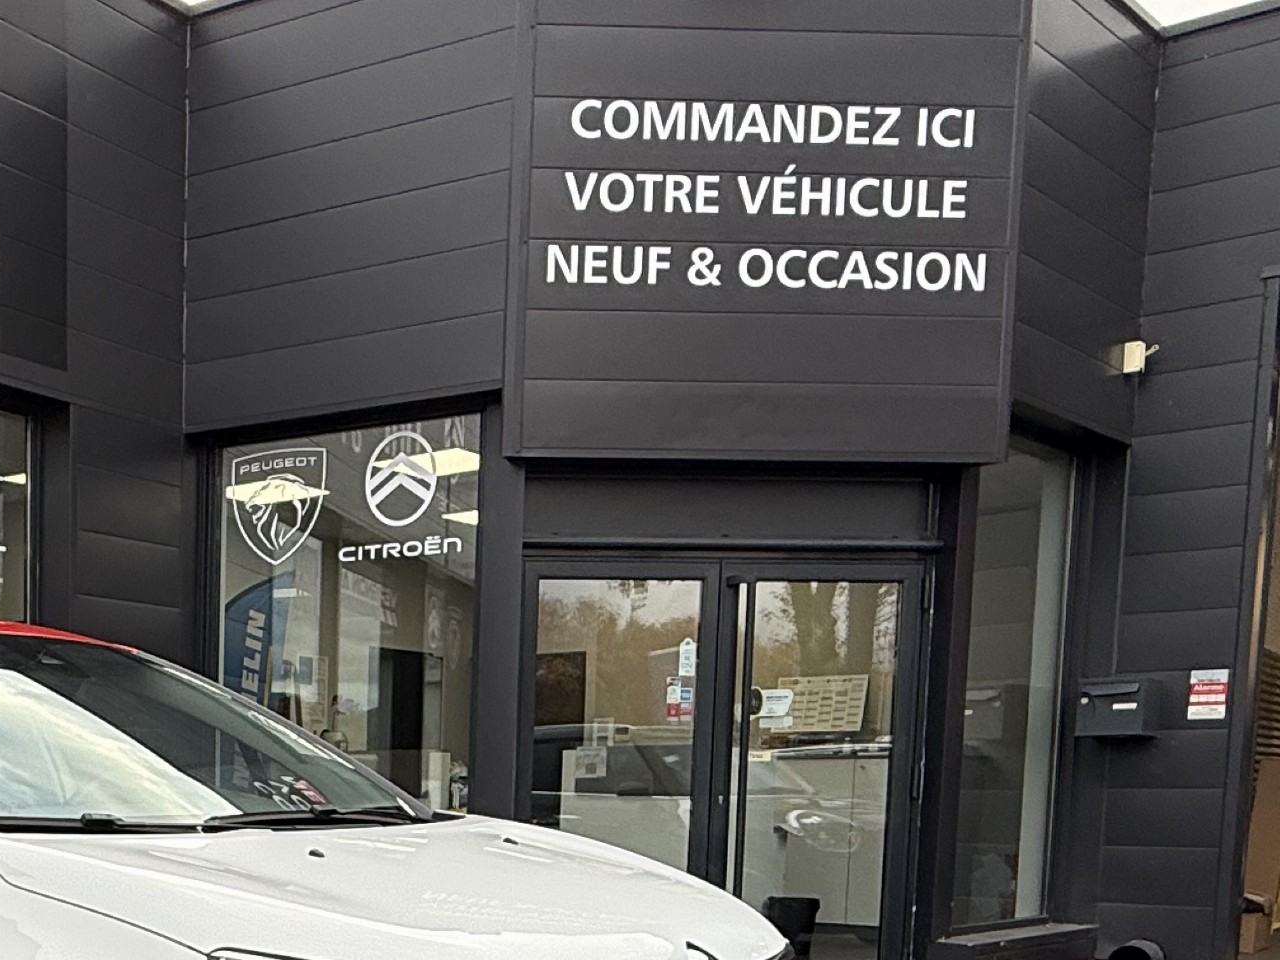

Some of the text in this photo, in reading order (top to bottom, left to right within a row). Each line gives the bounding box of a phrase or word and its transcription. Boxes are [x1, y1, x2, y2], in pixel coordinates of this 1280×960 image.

[570, 98, 977, 149] COMMANDEZ ICI
[564, 164, 968, 220] VOTRE VÉHICULE
[545, 243, 988, 293] NEUF & OCCASION
[240, 456, 317, 475] PEUGEOT
[241, 609, 267, 702] ELIN
